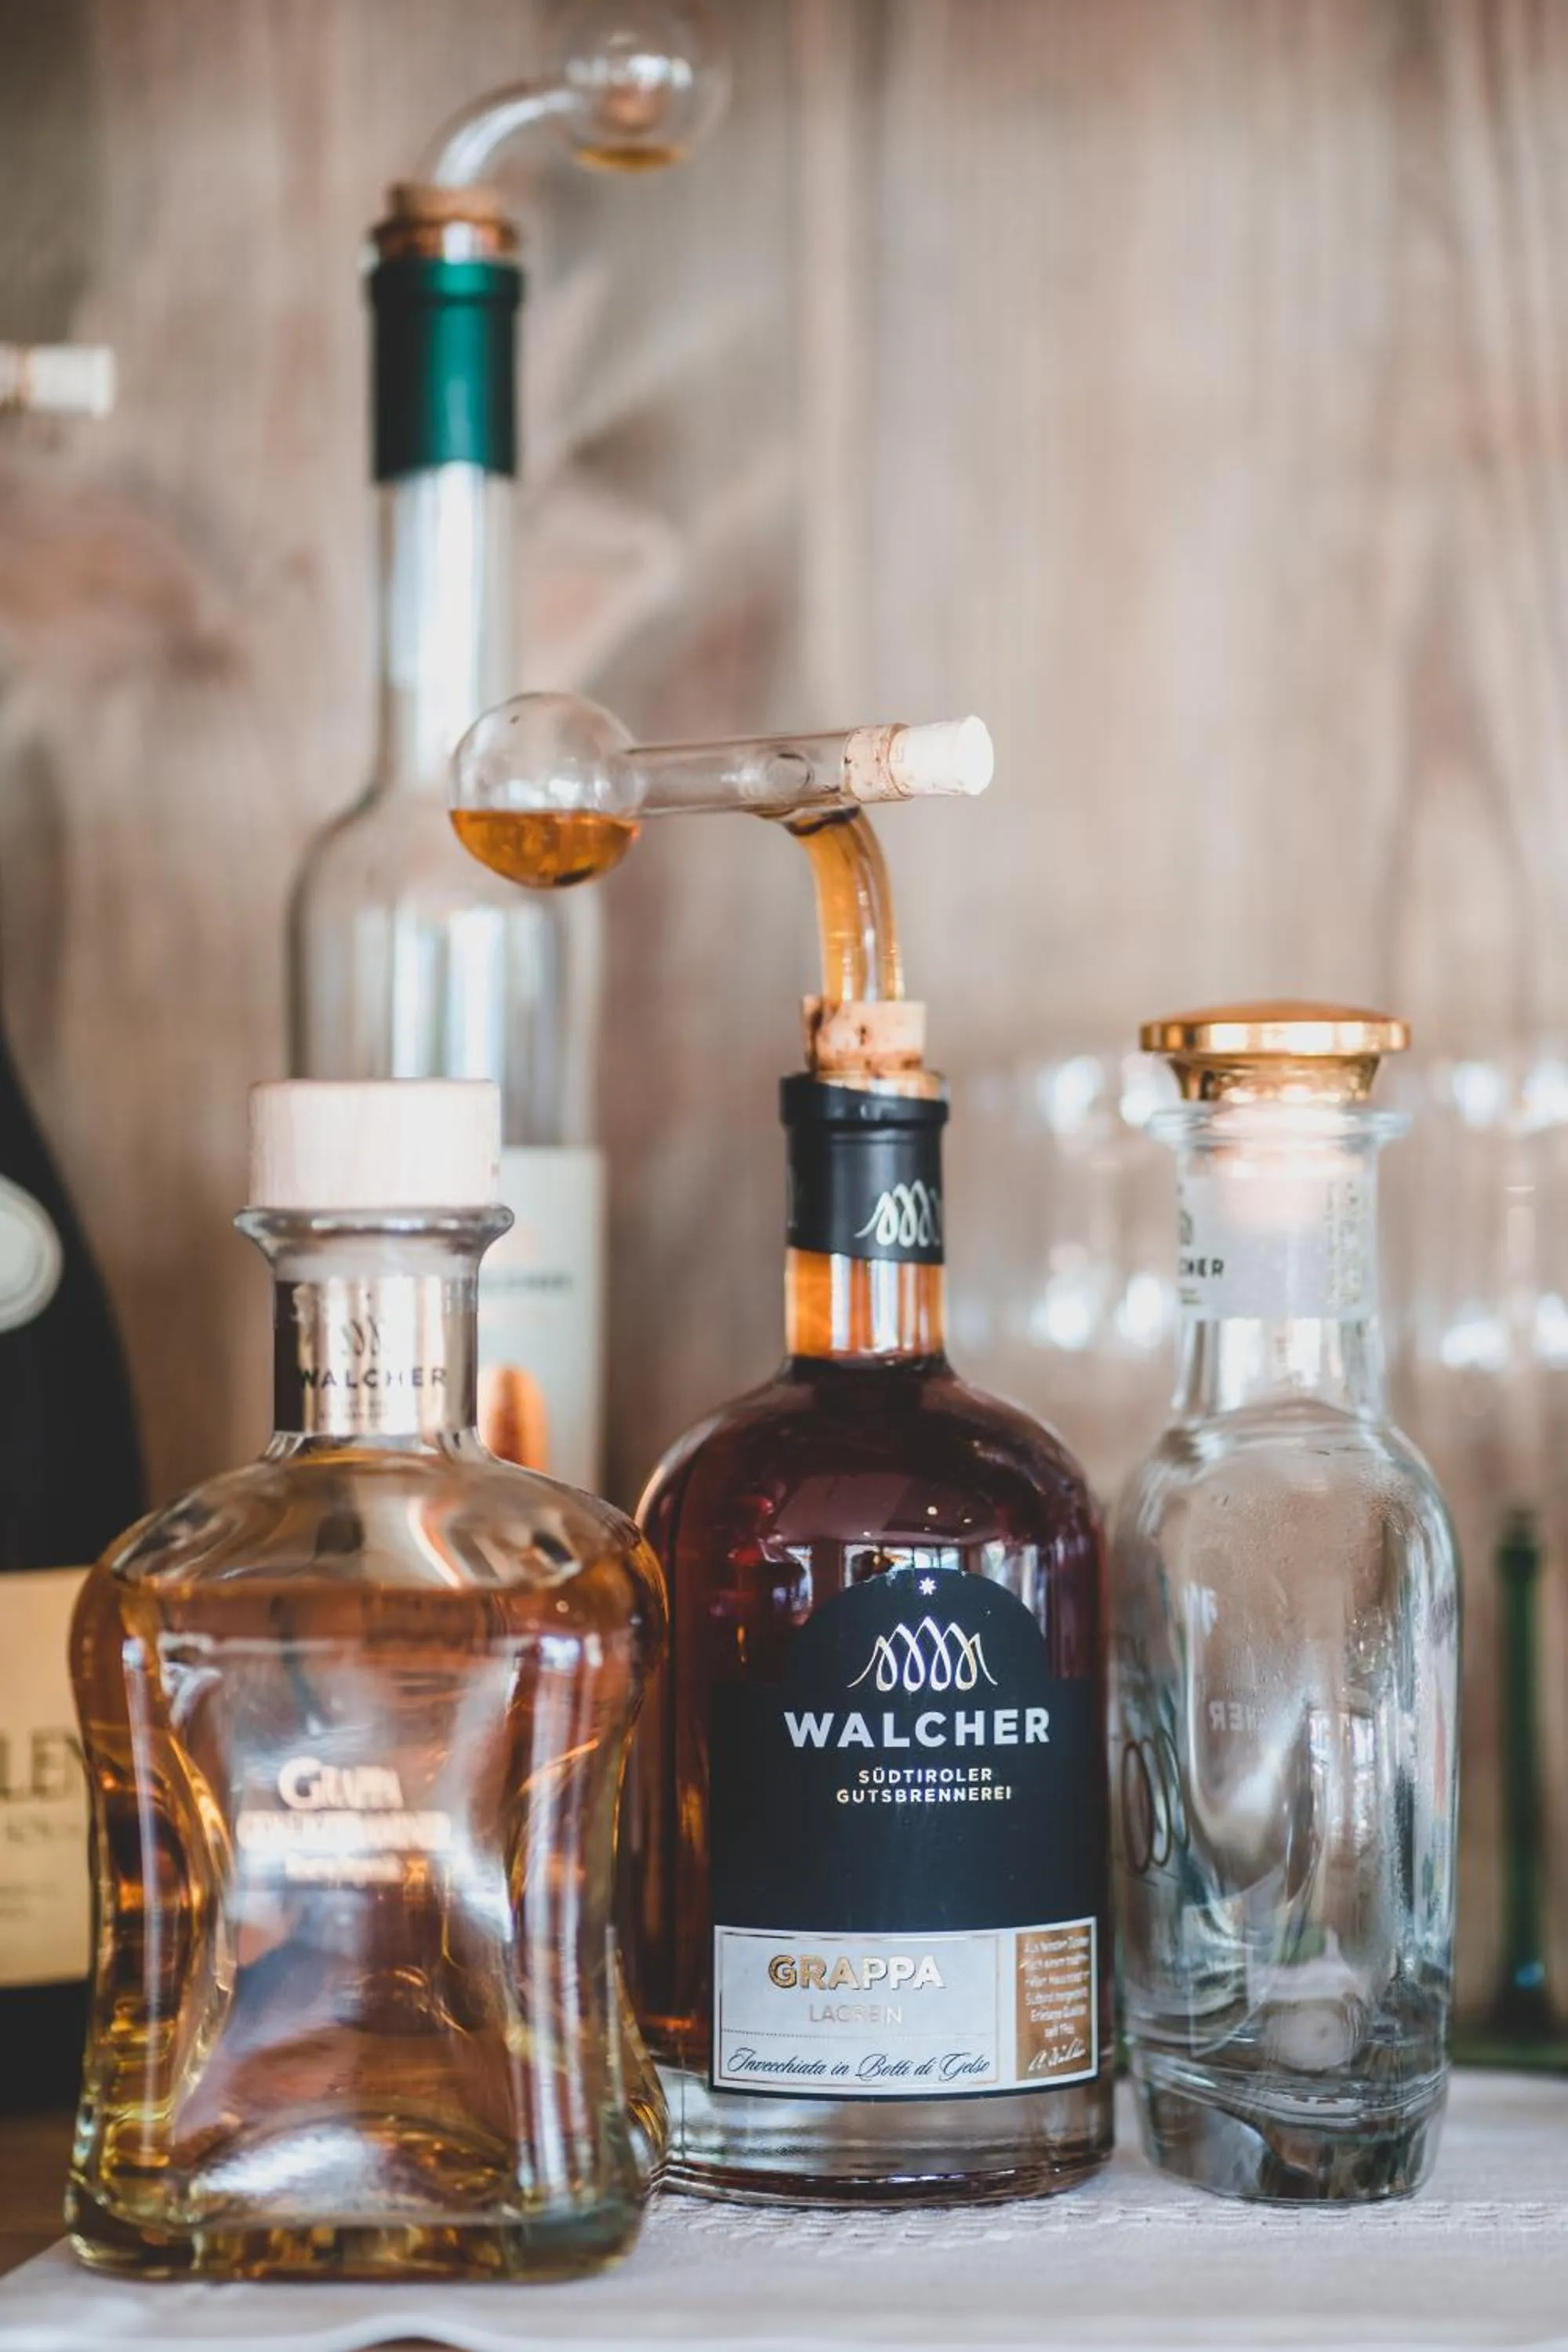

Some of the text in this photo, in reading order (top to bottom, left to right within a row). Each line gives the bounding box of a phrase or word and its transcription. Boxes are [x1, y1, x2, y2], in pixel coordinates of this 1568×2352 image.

[784, 1708, 1051, 1748] WALCHER
[858, 1767, 993, 1785] SÜDTIROLER
[836, 1786, 1012, 1803] GUTSBRENNEREI
[768, 1955, 946, 1990] GRAPPA
[727, 2047, 990, 2082] Invecchiata in Botti di Gelso
